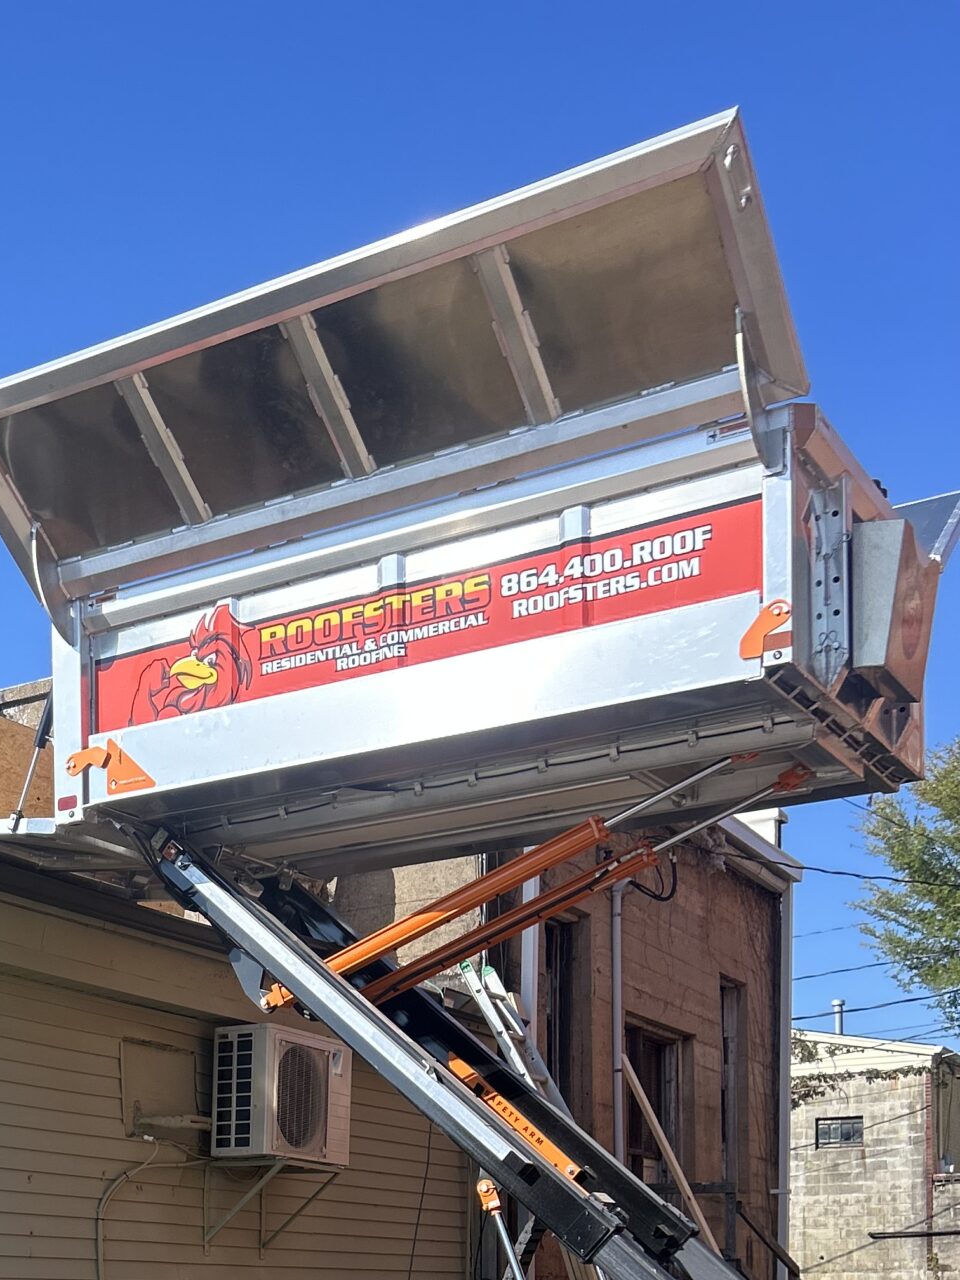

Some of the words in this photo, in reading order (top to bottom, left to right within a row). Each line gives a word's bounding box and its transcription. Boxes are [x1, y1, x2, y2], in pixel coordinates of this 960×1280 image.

[500, 525, 713, 597] 864.400.ROOF
[512, 557, 701, 618] ROOFSTERS.COM
[260, 574, 491, 660] ROOFSTERS
[261, 642, 362, 676] RESIDENTIAL
[364, 638, 378, 653] &
[380, 612, 489, 647] COMMERCIAL
[336, 643, 407, 672] ROOFING
[522, 1125, 544, 1147] ARM
